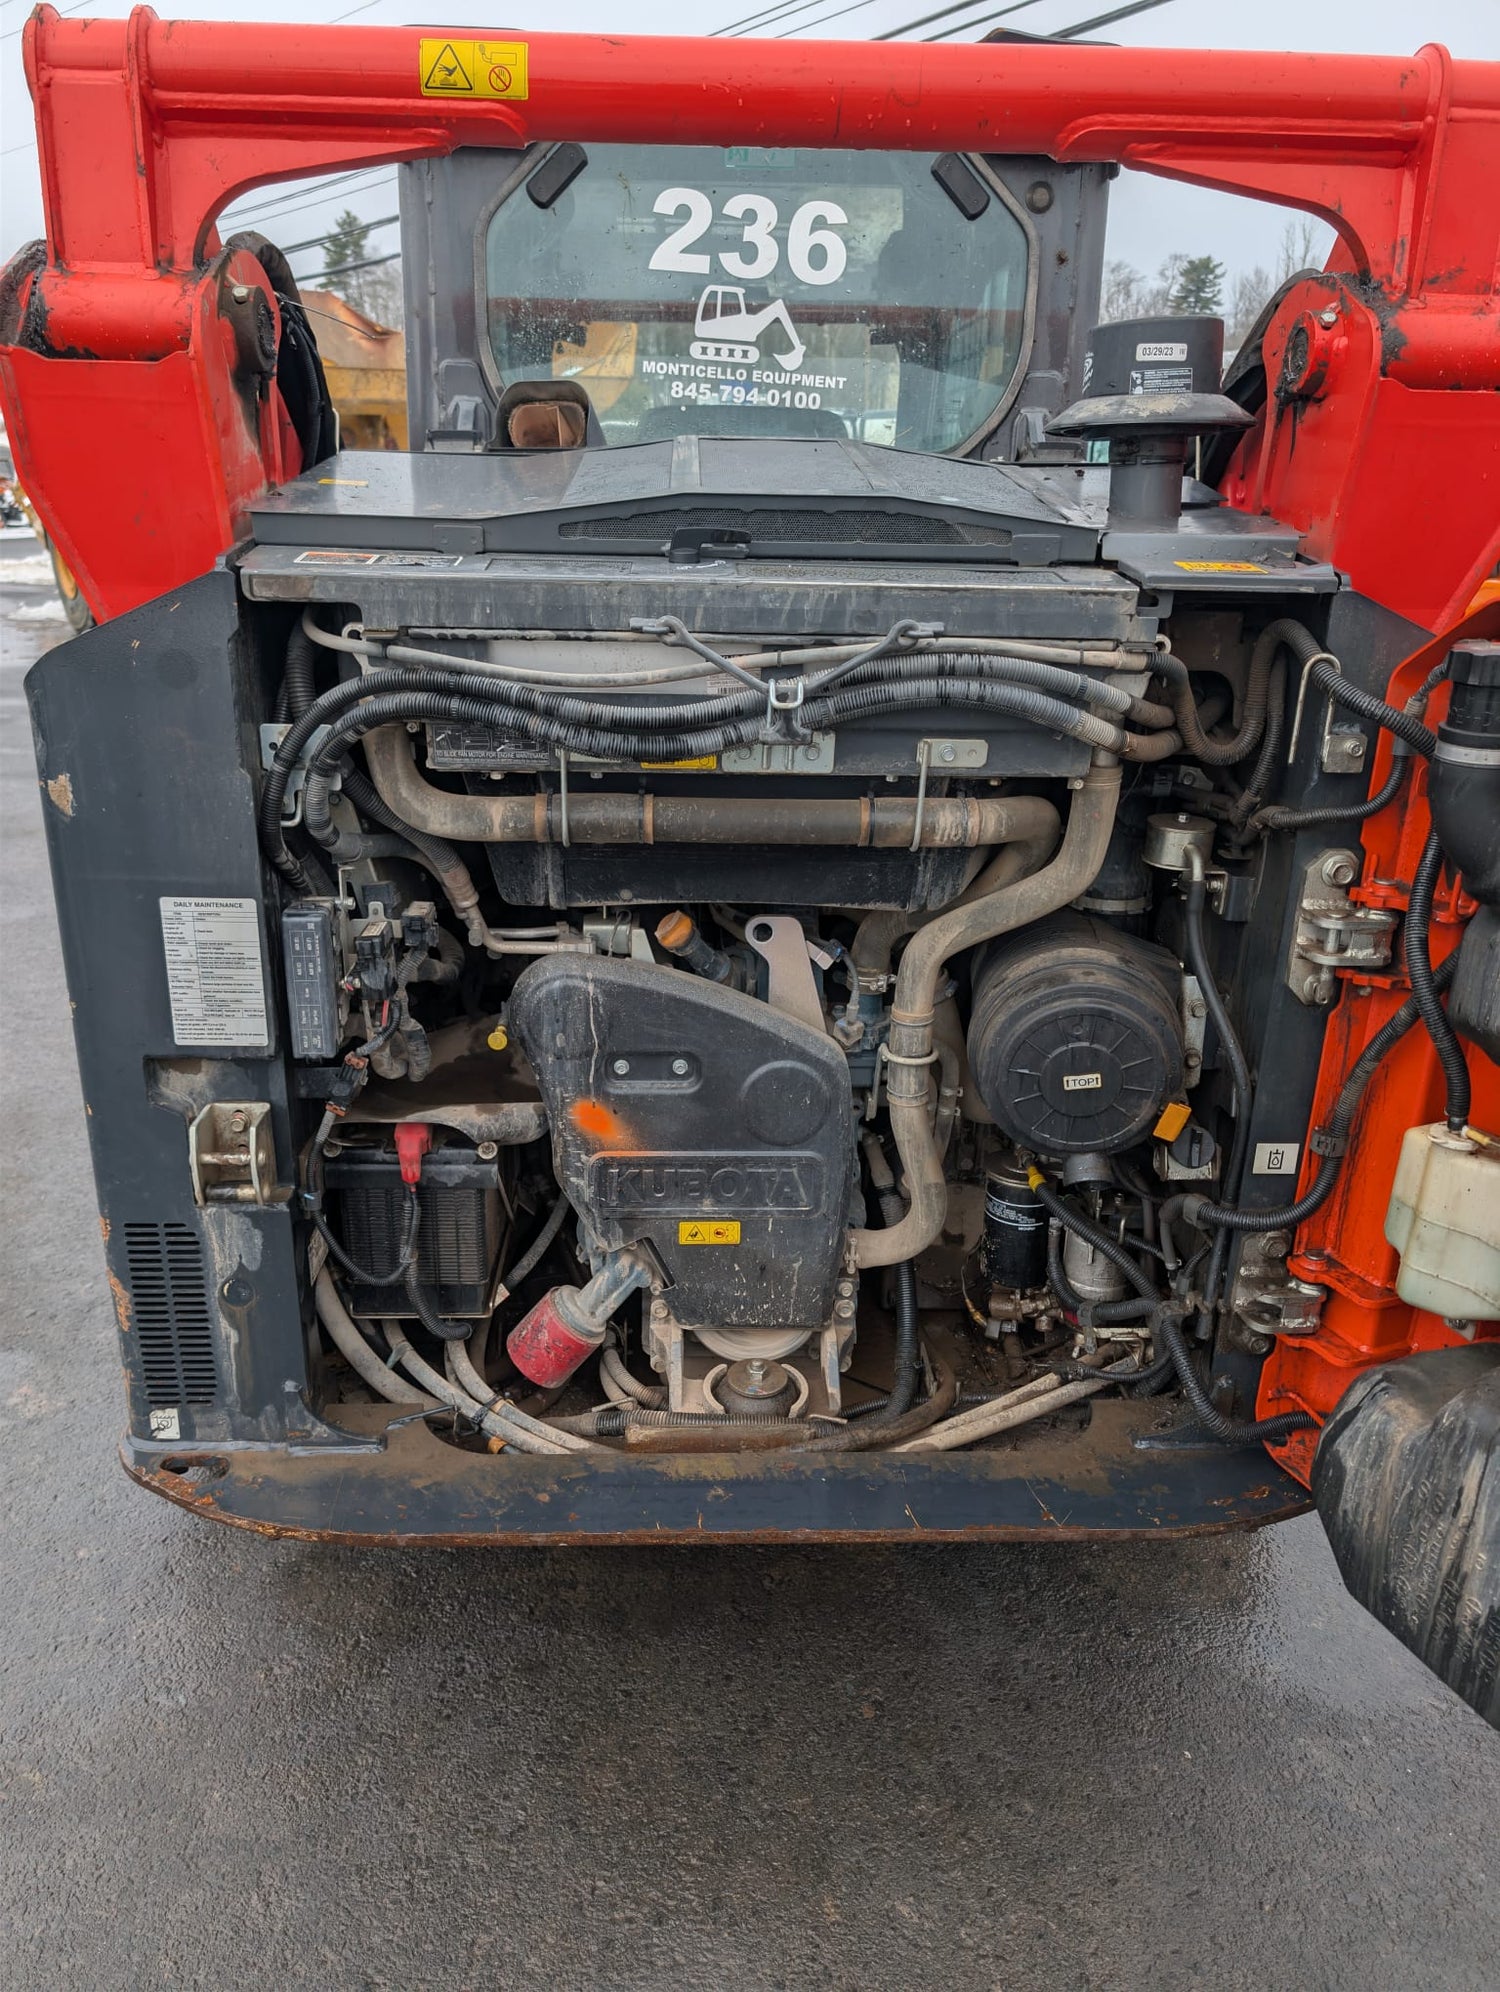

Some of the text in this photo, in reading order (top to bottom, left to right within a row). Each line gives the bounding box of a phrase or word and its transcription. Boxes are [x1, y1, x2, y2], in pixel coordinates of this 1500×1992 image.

[648, 187, 848, 285] 236
[1142, 347, 1174, 356] 03/29/23
[642, 360, 847, 389] MONTICELLO EQUIPMENT
[671, 381, 821, 409] 845-794-0100
[1071, 1078, 1094, 1087] TOP
[606, 1166, 809, 1206] KUBOTA
